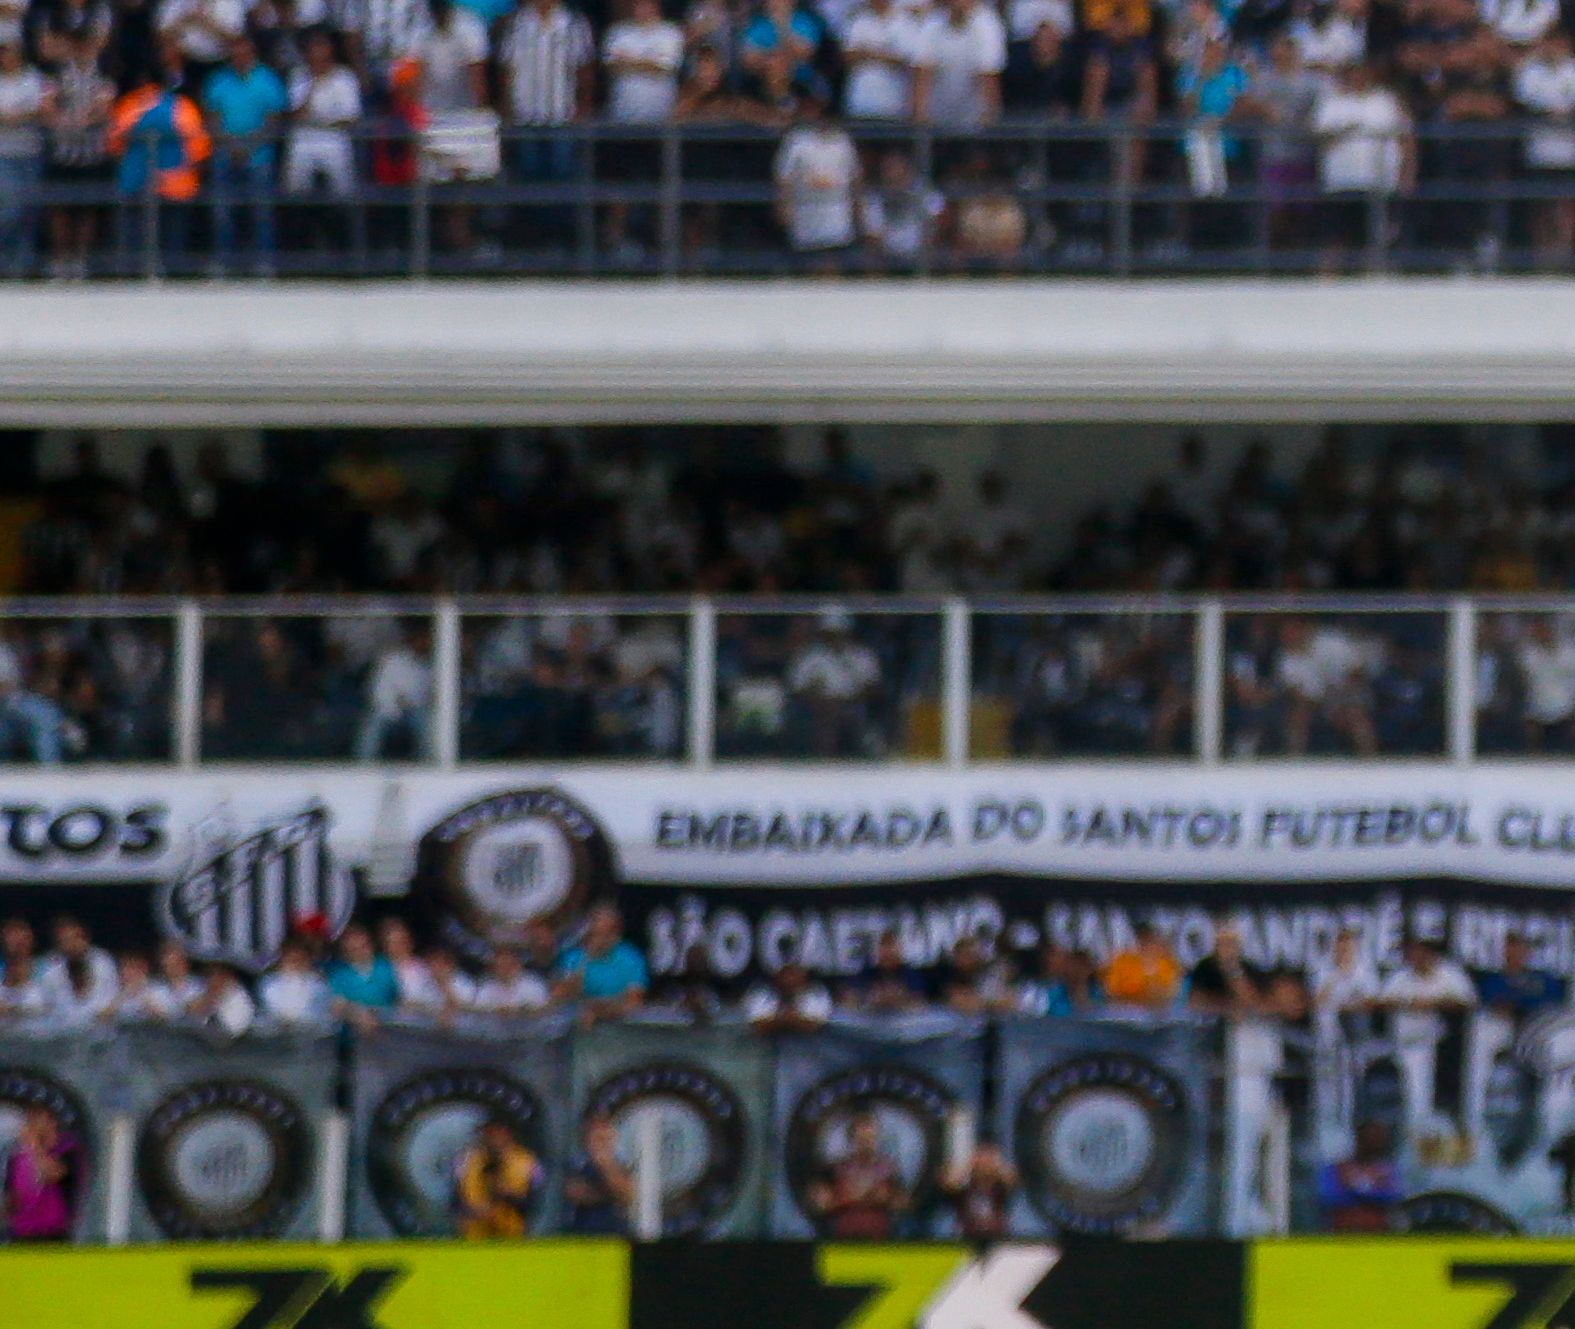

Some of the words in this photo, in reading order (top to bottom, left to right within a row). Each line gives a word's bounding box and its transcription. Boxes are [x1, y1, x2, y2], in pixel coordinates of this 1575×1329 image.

[656, 806, 952, 852] EMBAIXADA
[973, 797, 1044, 842] DO
[1063, 803, 1241, 847] SANTOS
[1260, 800, 1478, 847] FUTEBOL
